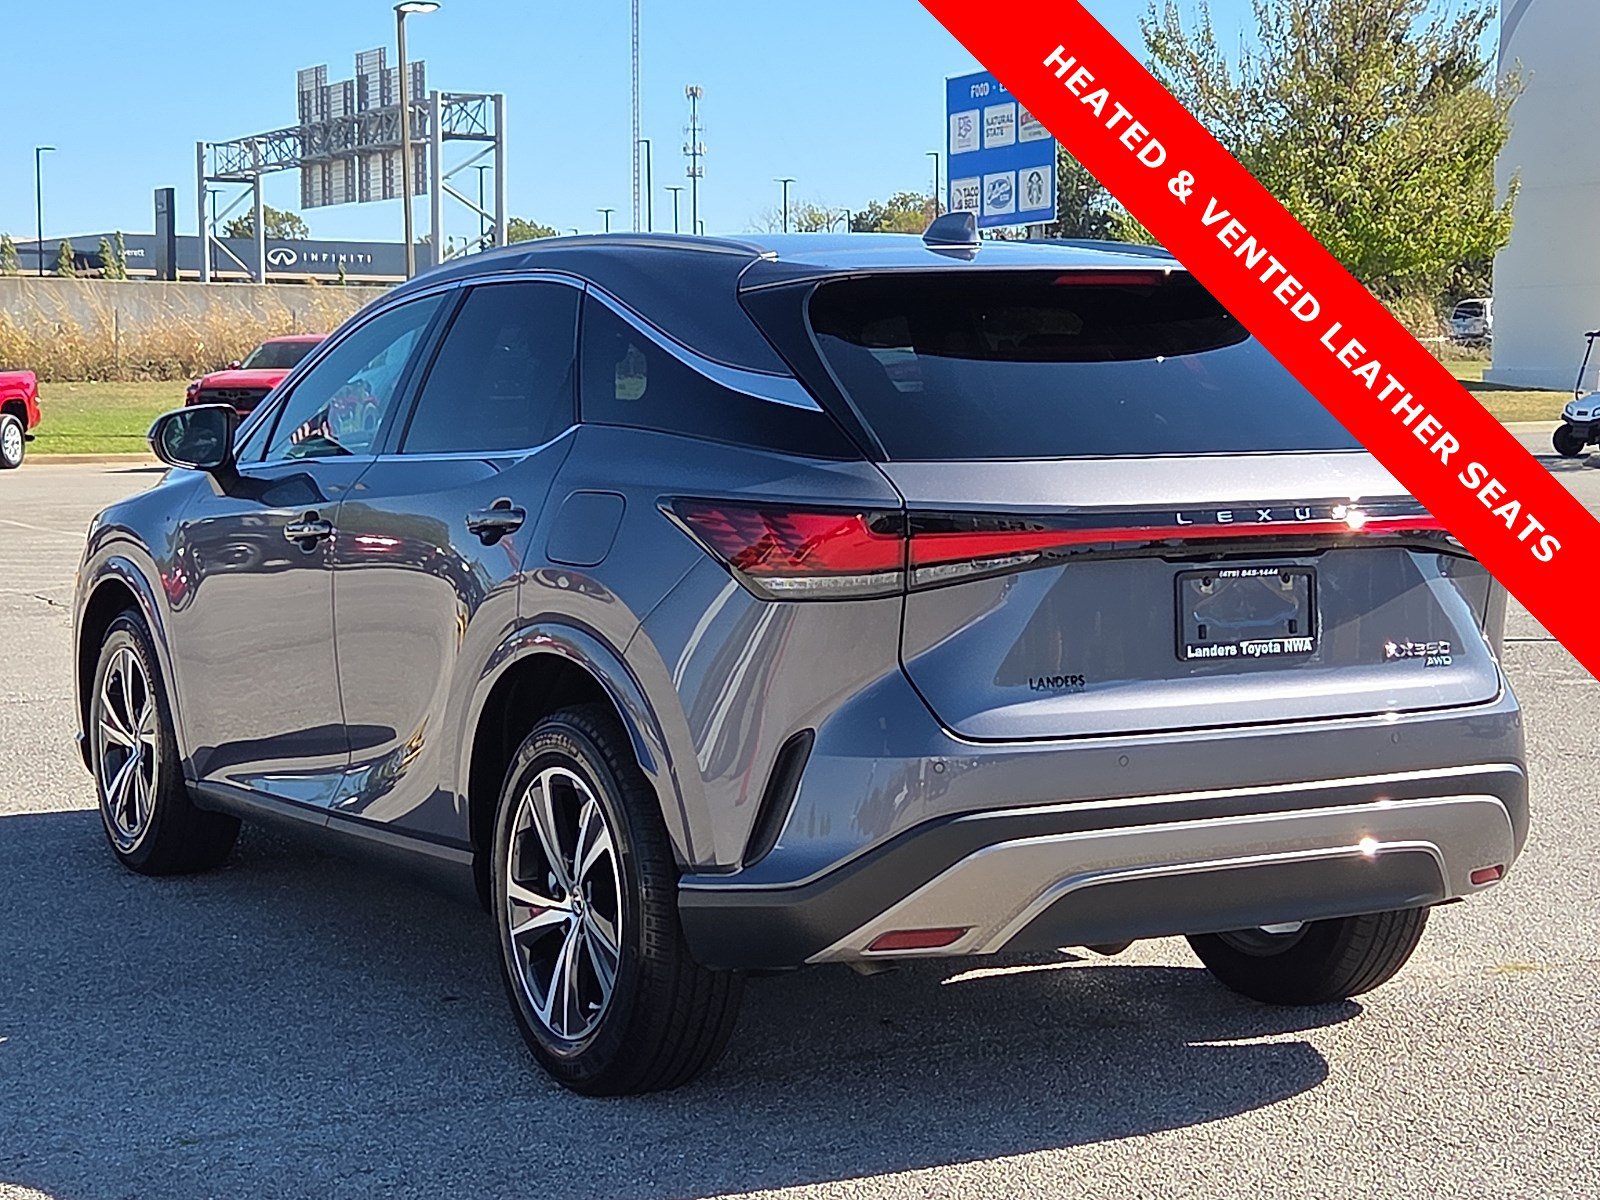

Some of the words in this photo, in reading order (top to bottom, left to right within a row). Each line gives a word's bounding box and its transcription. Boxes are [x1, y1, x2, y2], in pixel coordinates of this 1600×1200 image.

[970, 82, 990, 98] FOOD
[985, 113, 1014, 127] NATURAL
[986, 126, 1004, 138] STATE
[964, 197, 979, 210] BELL
[303, 252, 373, 264] INFINITI
[1176, 505, 1348, 525] LEXUS
[1187, 645, 1238, 658] Landers
[1240, 641, 1281, 657] Toyota
[1284, 639, 1313, 653] NWA
[1426, 655, 1453, 666] AWD
[1029, 674, 1086, 691] LANDERS
